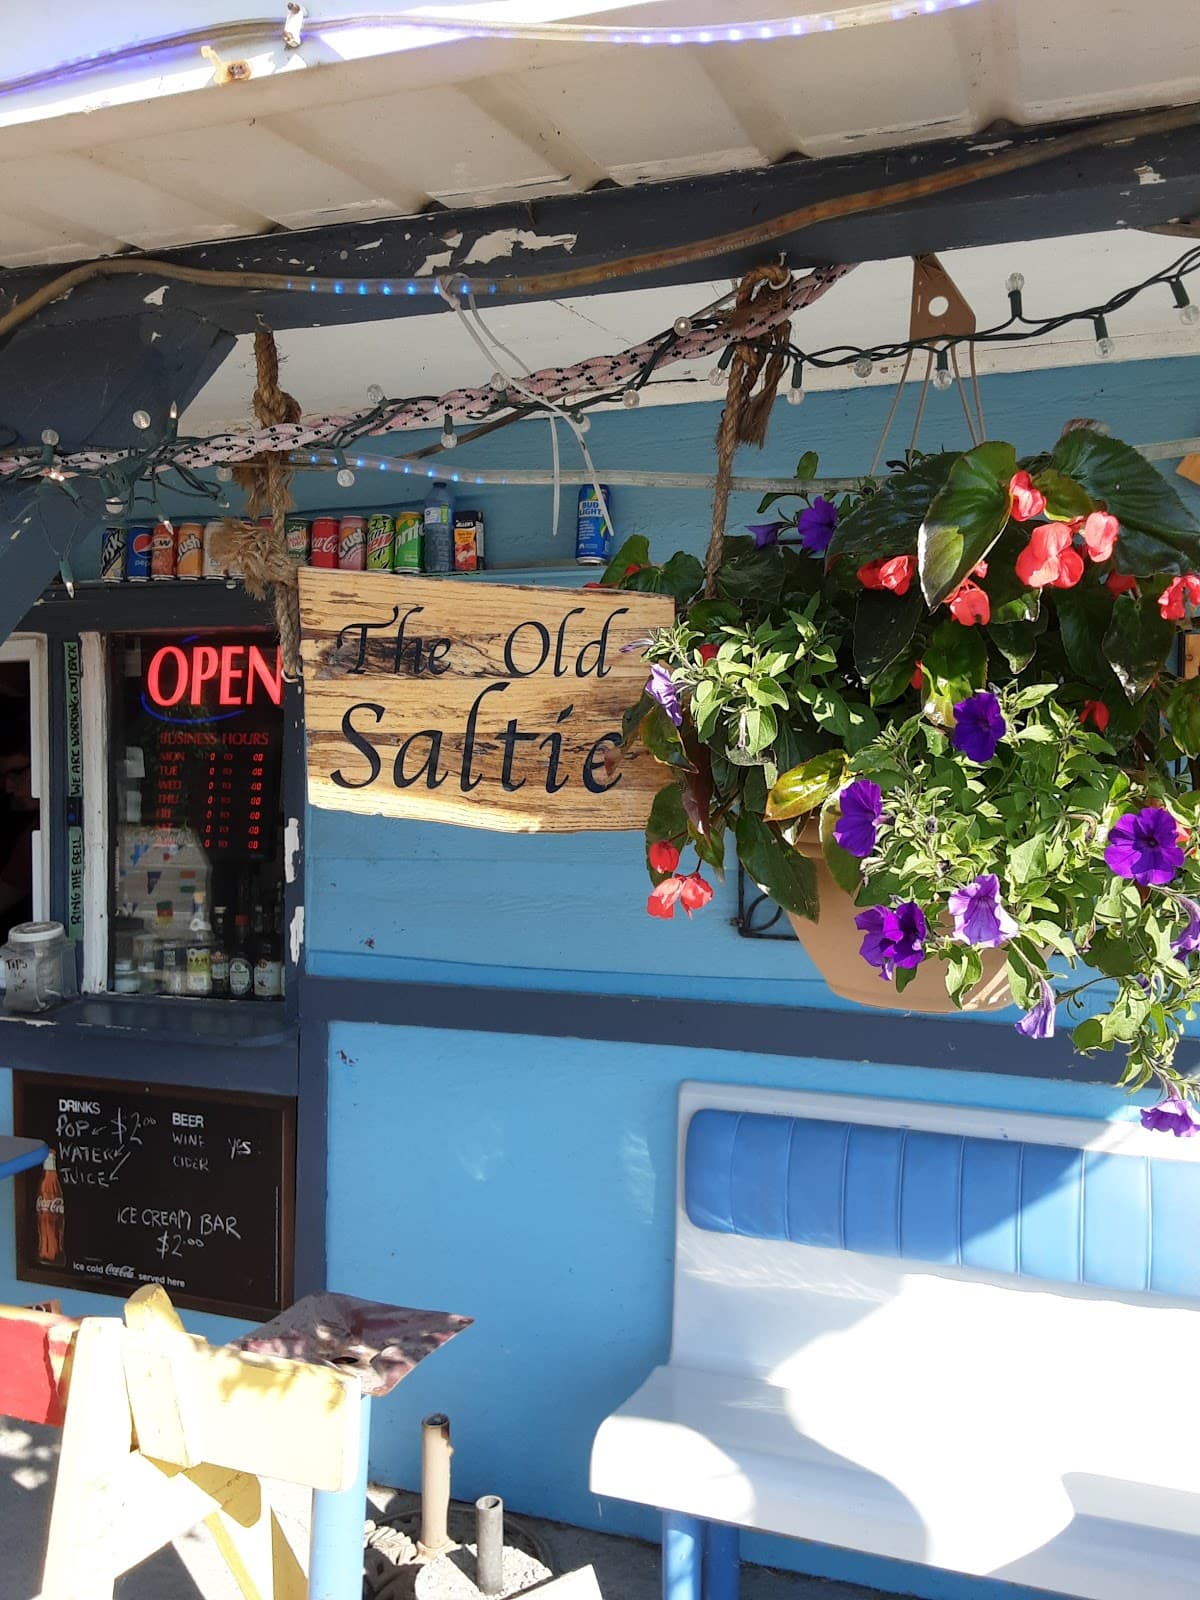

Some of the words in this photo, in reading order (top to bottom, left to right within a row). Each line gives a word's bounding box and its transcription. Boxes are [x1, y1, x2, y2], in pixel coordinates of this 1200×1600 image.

[579, 508, 602, 516] LIGHT
[582, 501, 600, 509] BUD
[336, 604, 452, 675] The
[503, 607, 629, 678] Old
[147, 645, 284, 706] OPEN
[159, 731, 217, 745] BUSINESS
[221, 731, 269, 745] HOURS
[330, 682, 624, 794] Saltie
[70, 778, 81, 796] WE
[71, 834, 82, 865] BELL
[71, 868, 82, 890] THE
[70, 892, 82, 925] RING
[58, 1098, 101, 1115] DRINKS
[55, 1113, 90, 1137] POP
[171, 1112, 205, 1128] BEER
[59, 1141, 114, 1164] WATER
[60, 1166, 110, 1188] JUICE
[117, 1206, 137, 1225] ICE
[141, 1208, 192, 1231] CREAM
[200, 1213, 242, 1240] BAR
[86, 1264, 104, 1275] cold
[138, 1273, 165, 1285] served
[167, 1277, 186, 1288] here
